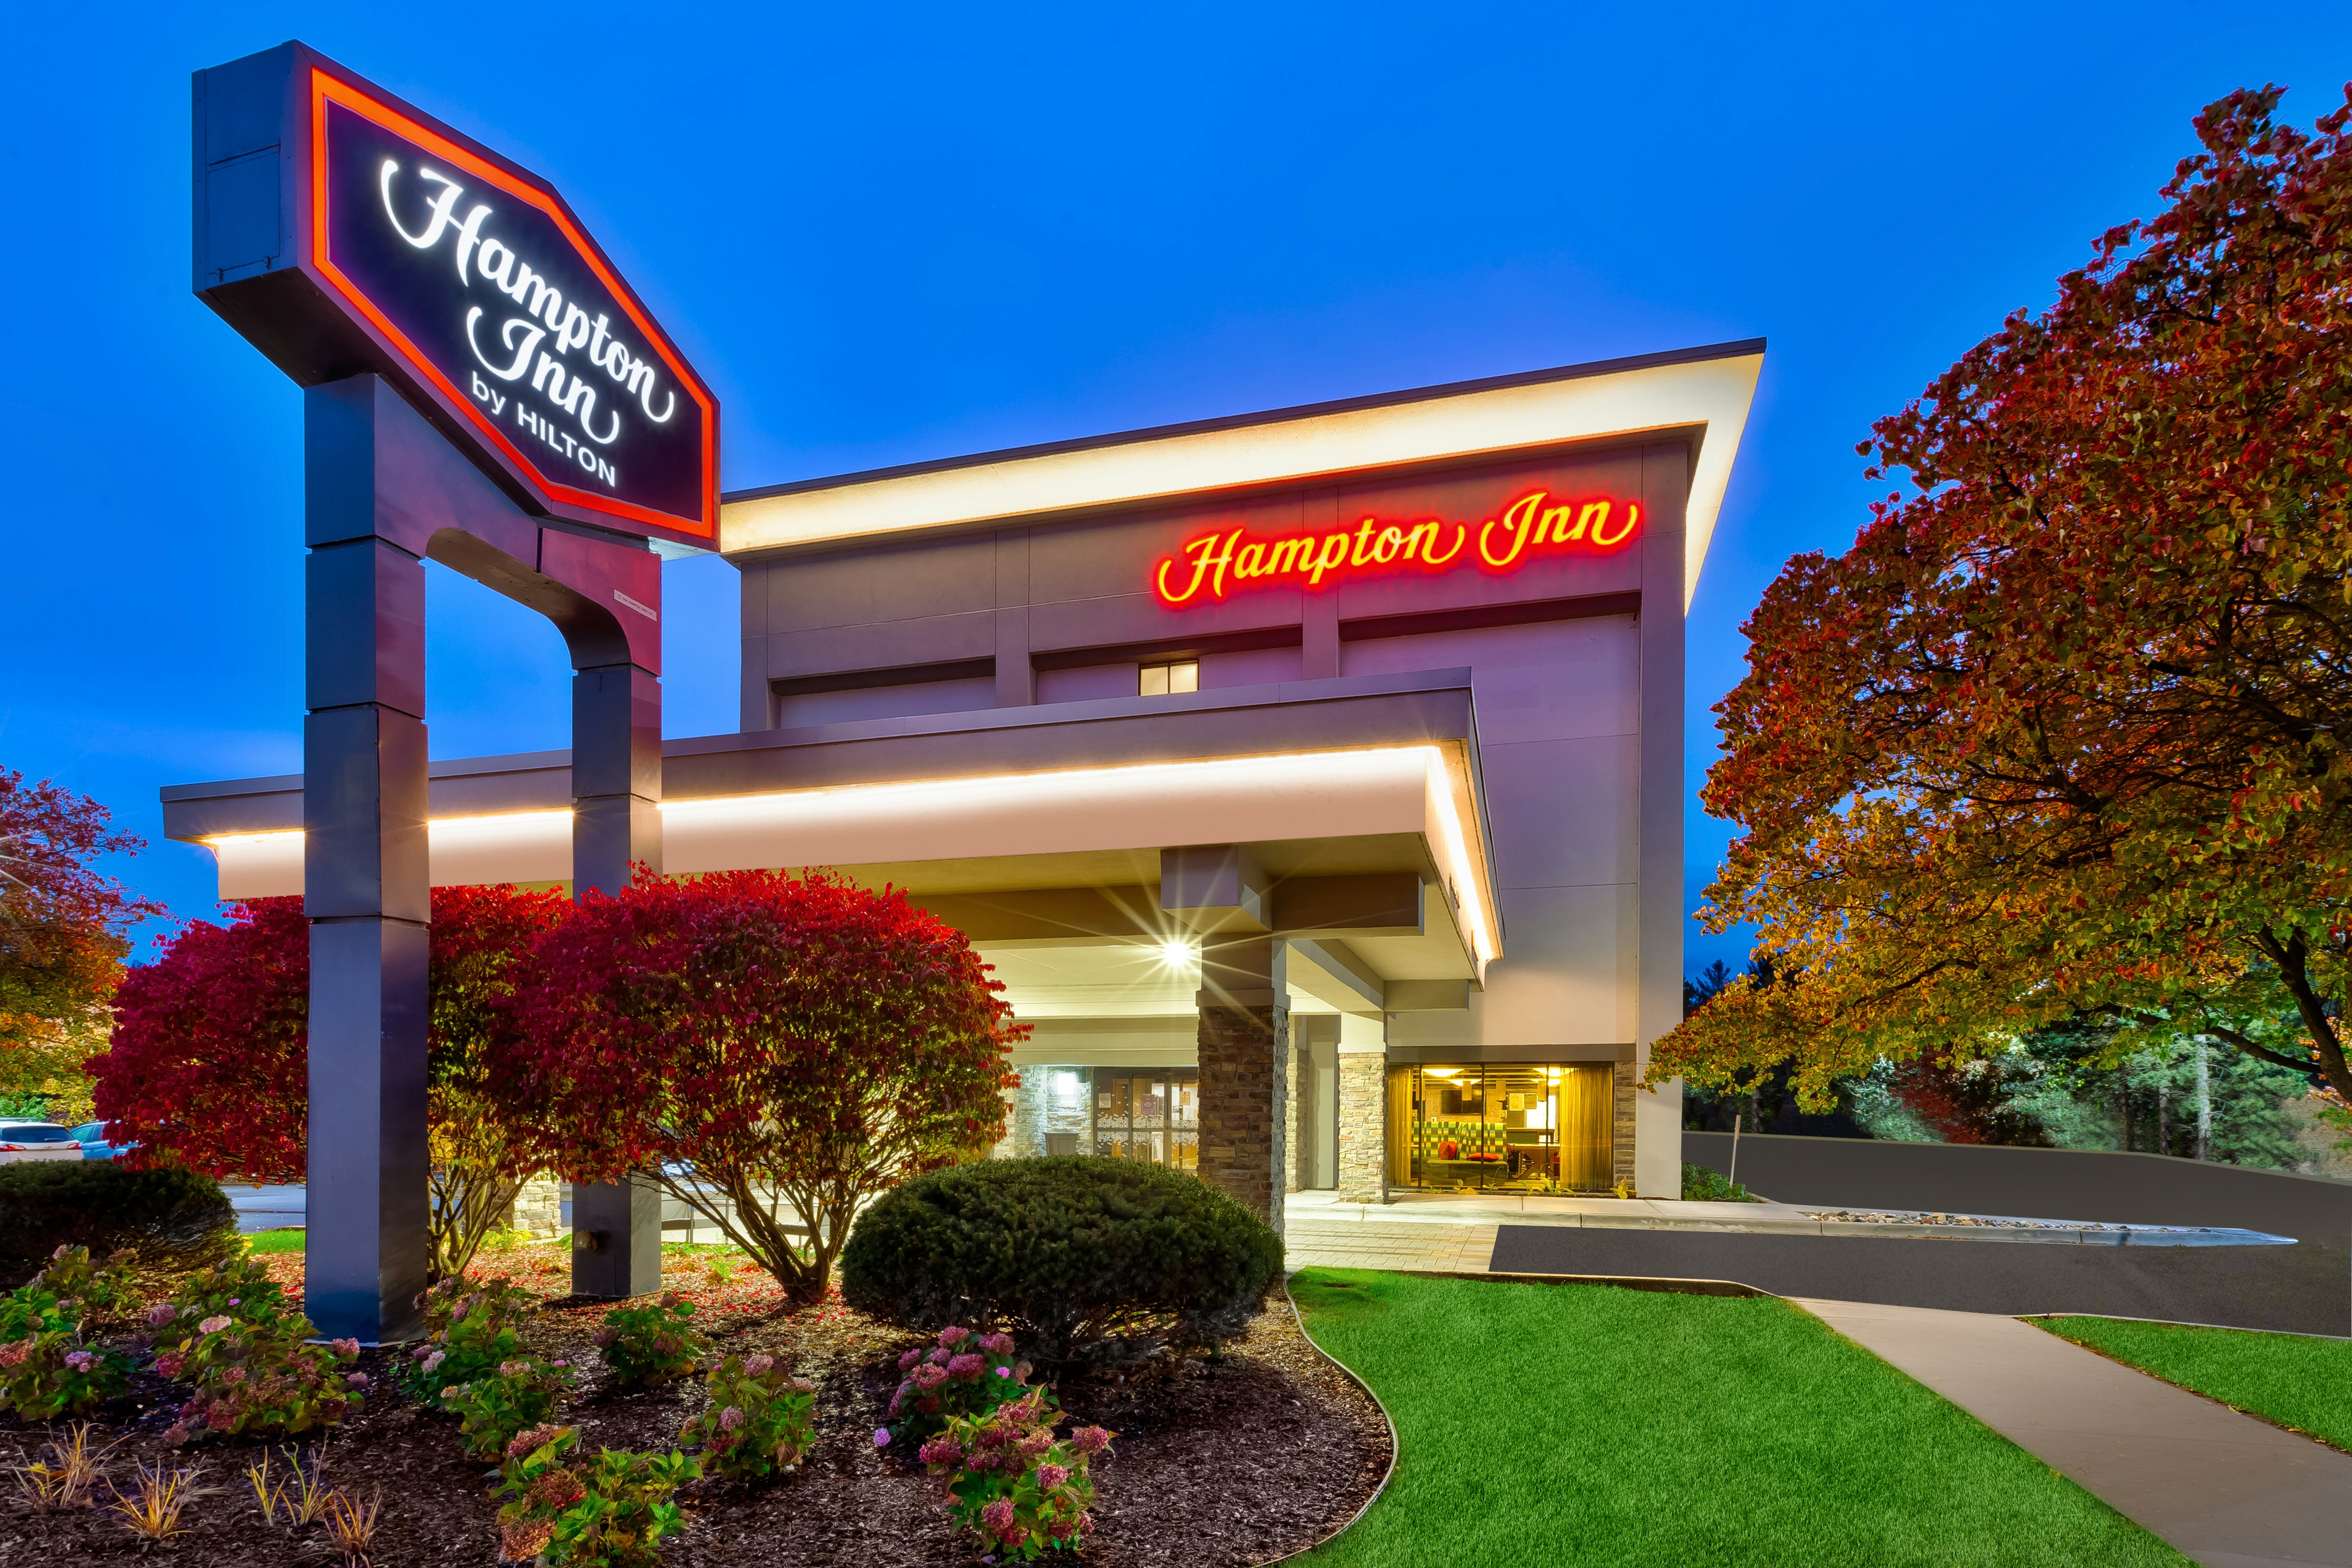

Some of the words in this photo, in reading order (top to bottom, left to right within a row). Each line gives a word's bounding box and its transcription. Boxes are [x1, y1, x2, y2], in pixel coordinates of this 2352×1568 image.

[380, 158, 675, 423] Hampton
[466, 306, 620, 444] Inn
[472, 371, 506, 415] by
[518, 402, 616, 487] HILTON
[1158, 518, 1465, 602] Hampton
[1480, 492, 1638, 566] Inn
